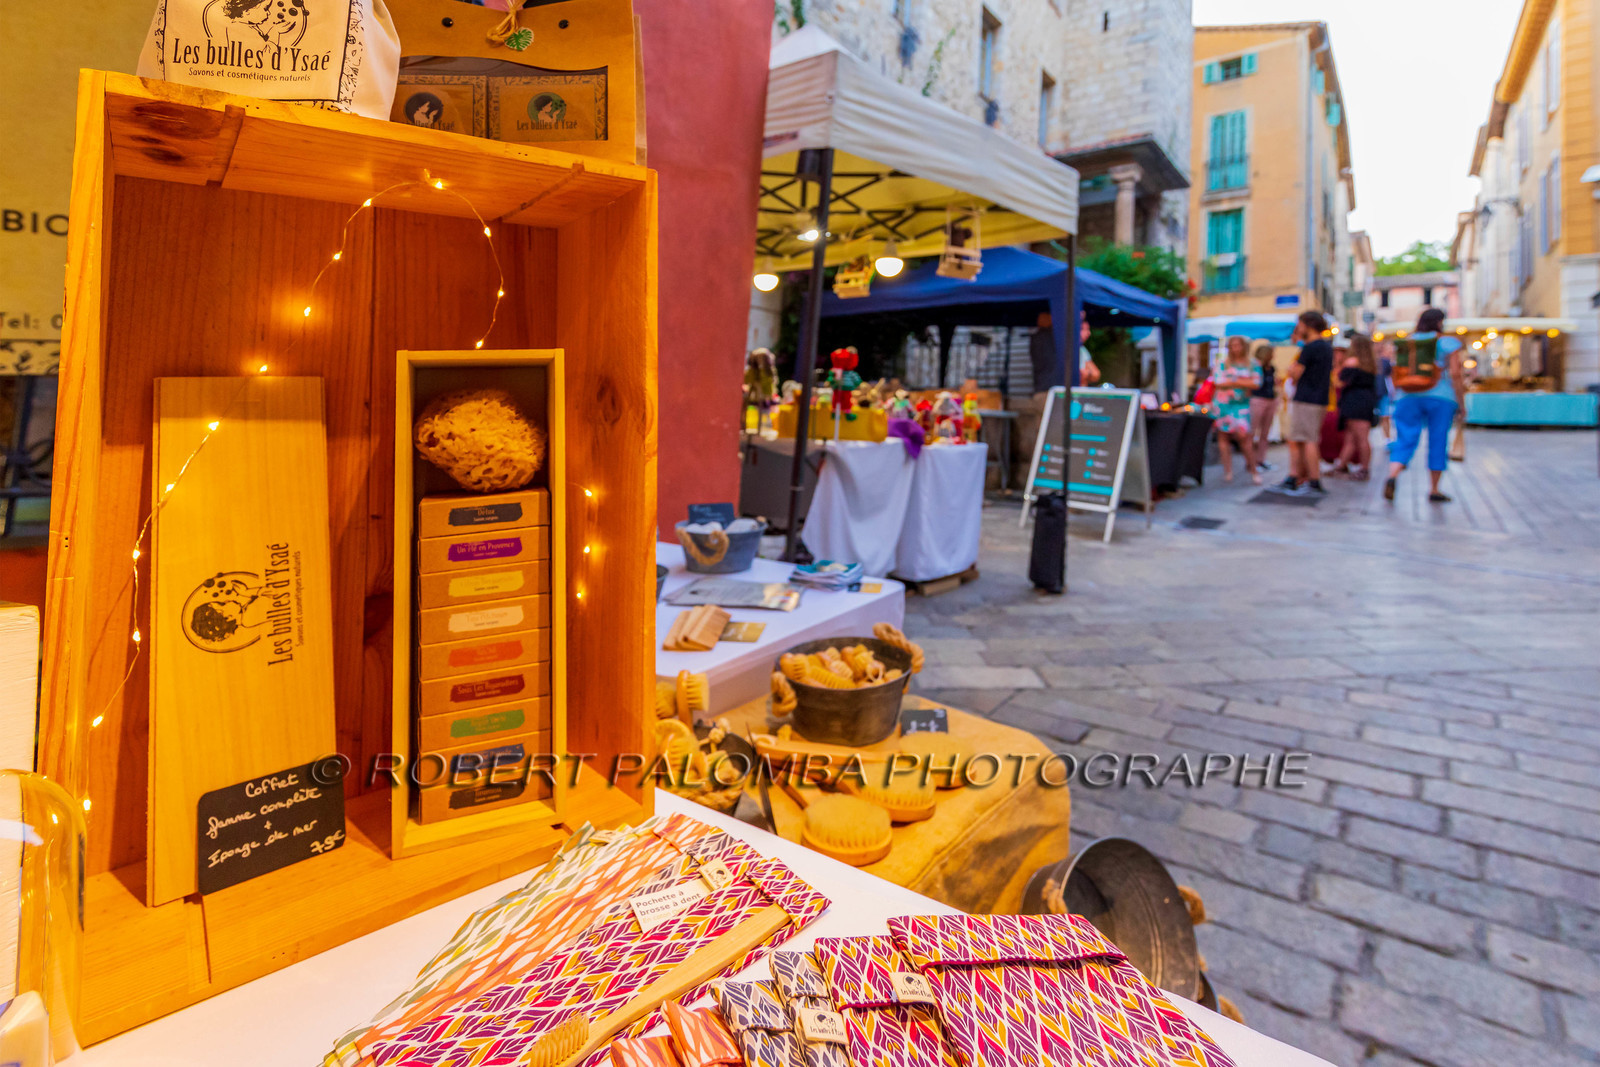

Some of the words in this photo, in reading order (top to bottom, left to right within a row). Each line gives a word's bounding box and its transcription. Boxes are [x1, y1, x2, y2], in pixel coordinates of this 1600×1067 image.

[173, 38, 199, 64] Les
[206, 39, 264, 69] bulles
[271, 46, 331, 72] d'Ysaé
[188, 67, 215, 77] Savons
[216, 69, 224, 77] et
[227, 71, 277, 82] cosmétiques
[279, 74, 311, 82] naturels
[516, 119, 529, 131] Les
[531, 119, 552, 130] bulles
[265, 542, 290, 589] d'Ysaé
[266, 592, 292, 638] bulles
[268, 638, 293, 666] Les
[245, 774, 299, 798] Coffret
[265, 830, 289, 846] de
[292, 819, 318, 836] mer
[635, 893, 676, 908] Pochette
[639, 904, 671, 916] brosse
[680, 893, 702, 904] dent
